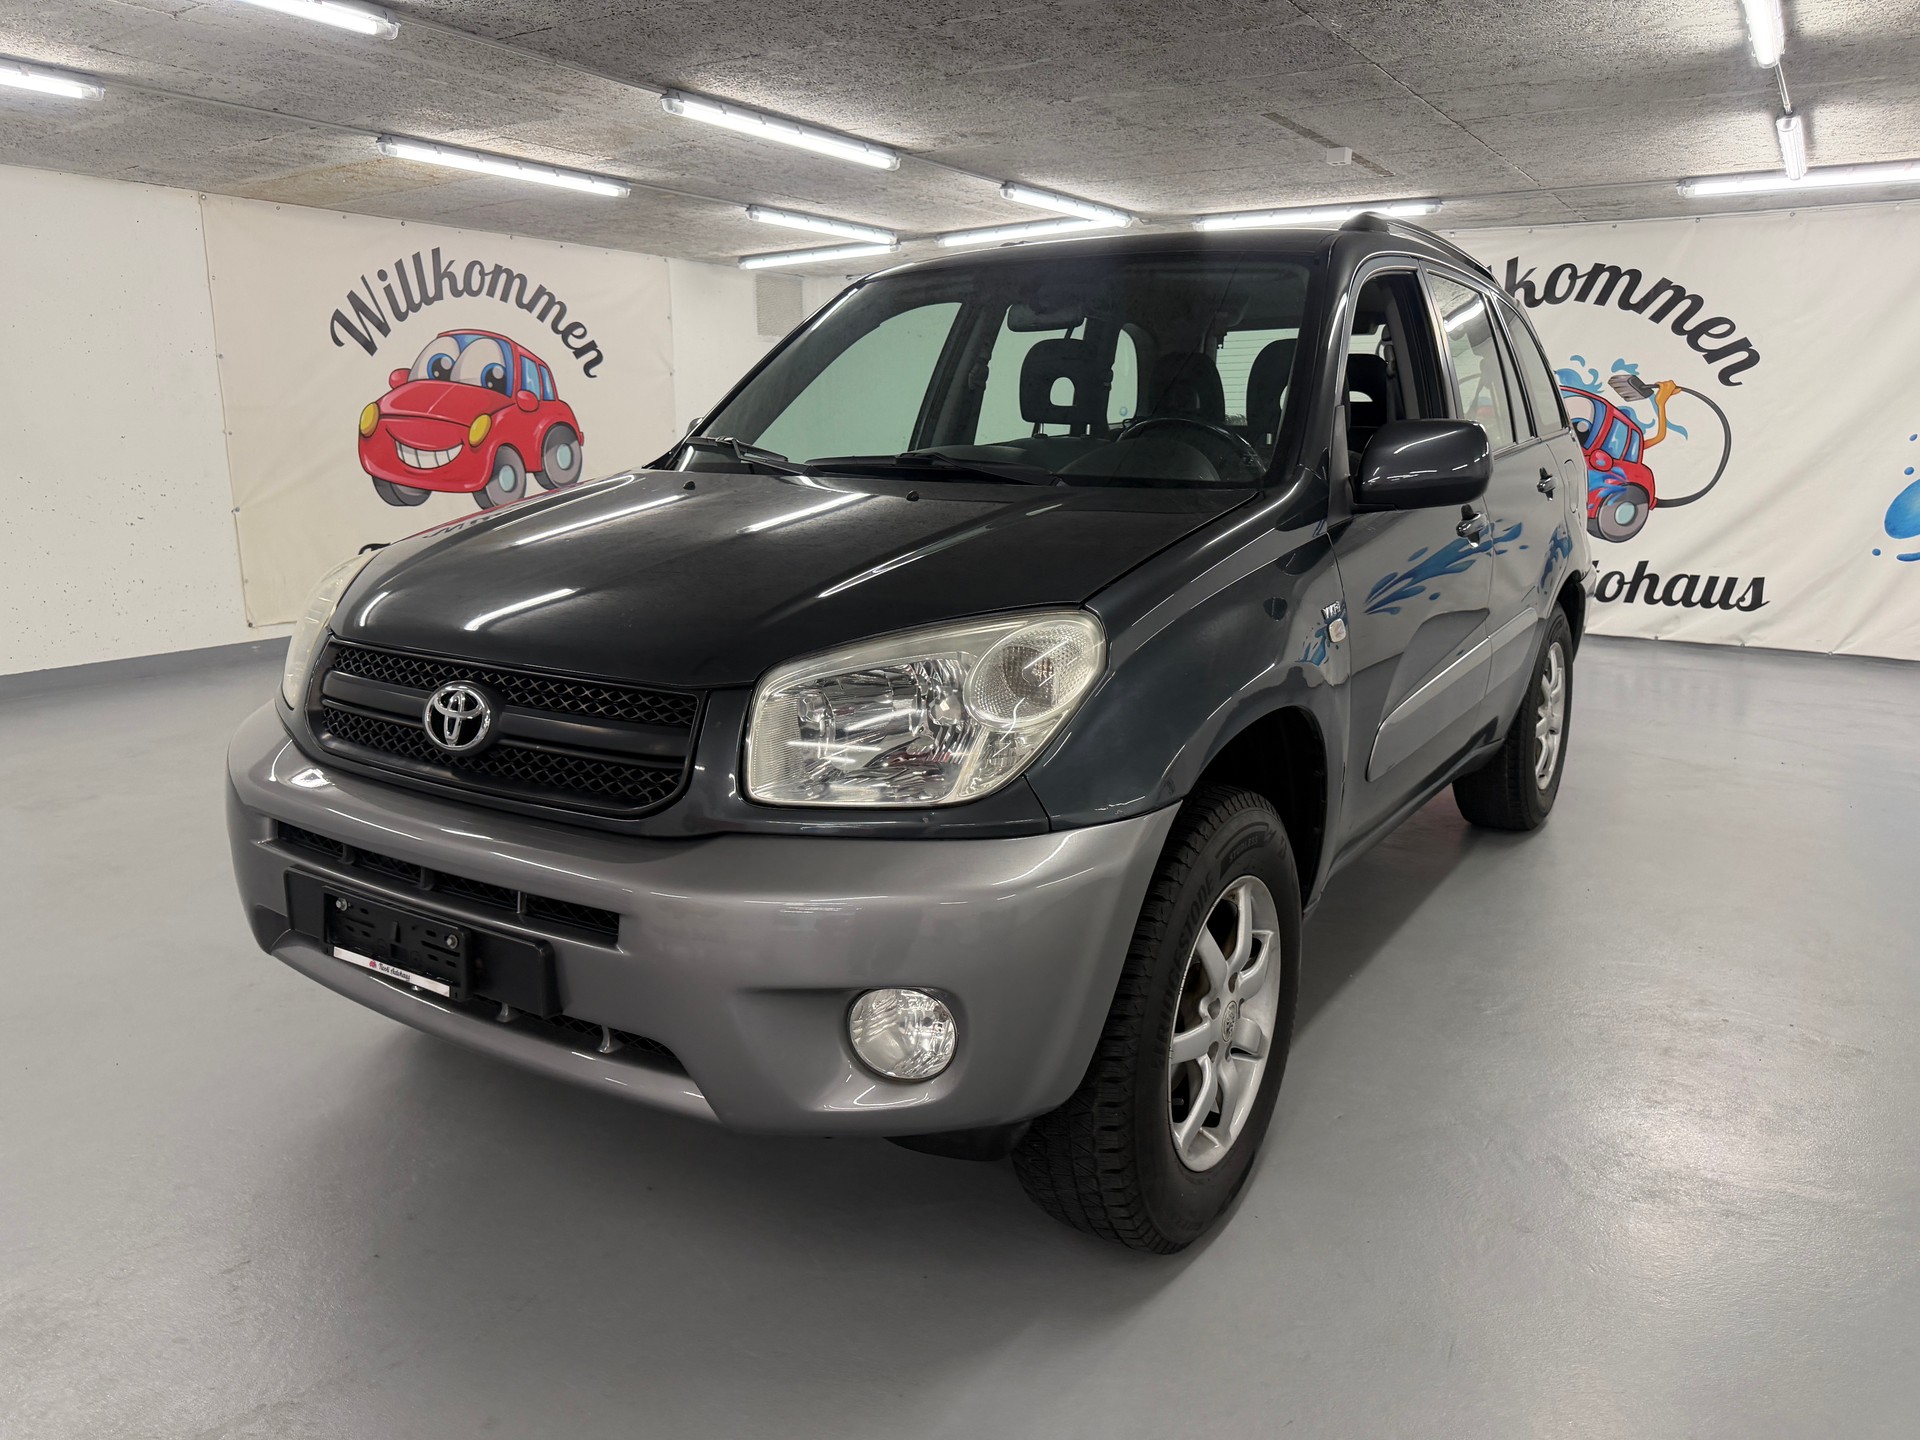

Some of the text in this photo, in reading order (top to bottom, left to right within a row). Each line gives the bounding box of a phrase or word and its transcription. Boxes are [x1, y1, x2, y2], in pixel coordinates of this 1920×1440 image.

[330, 247, 604, 379] Willkommen
[1487, 256, 1761, 387] kommen
[1592, 560, 1771, 612] ohaus
